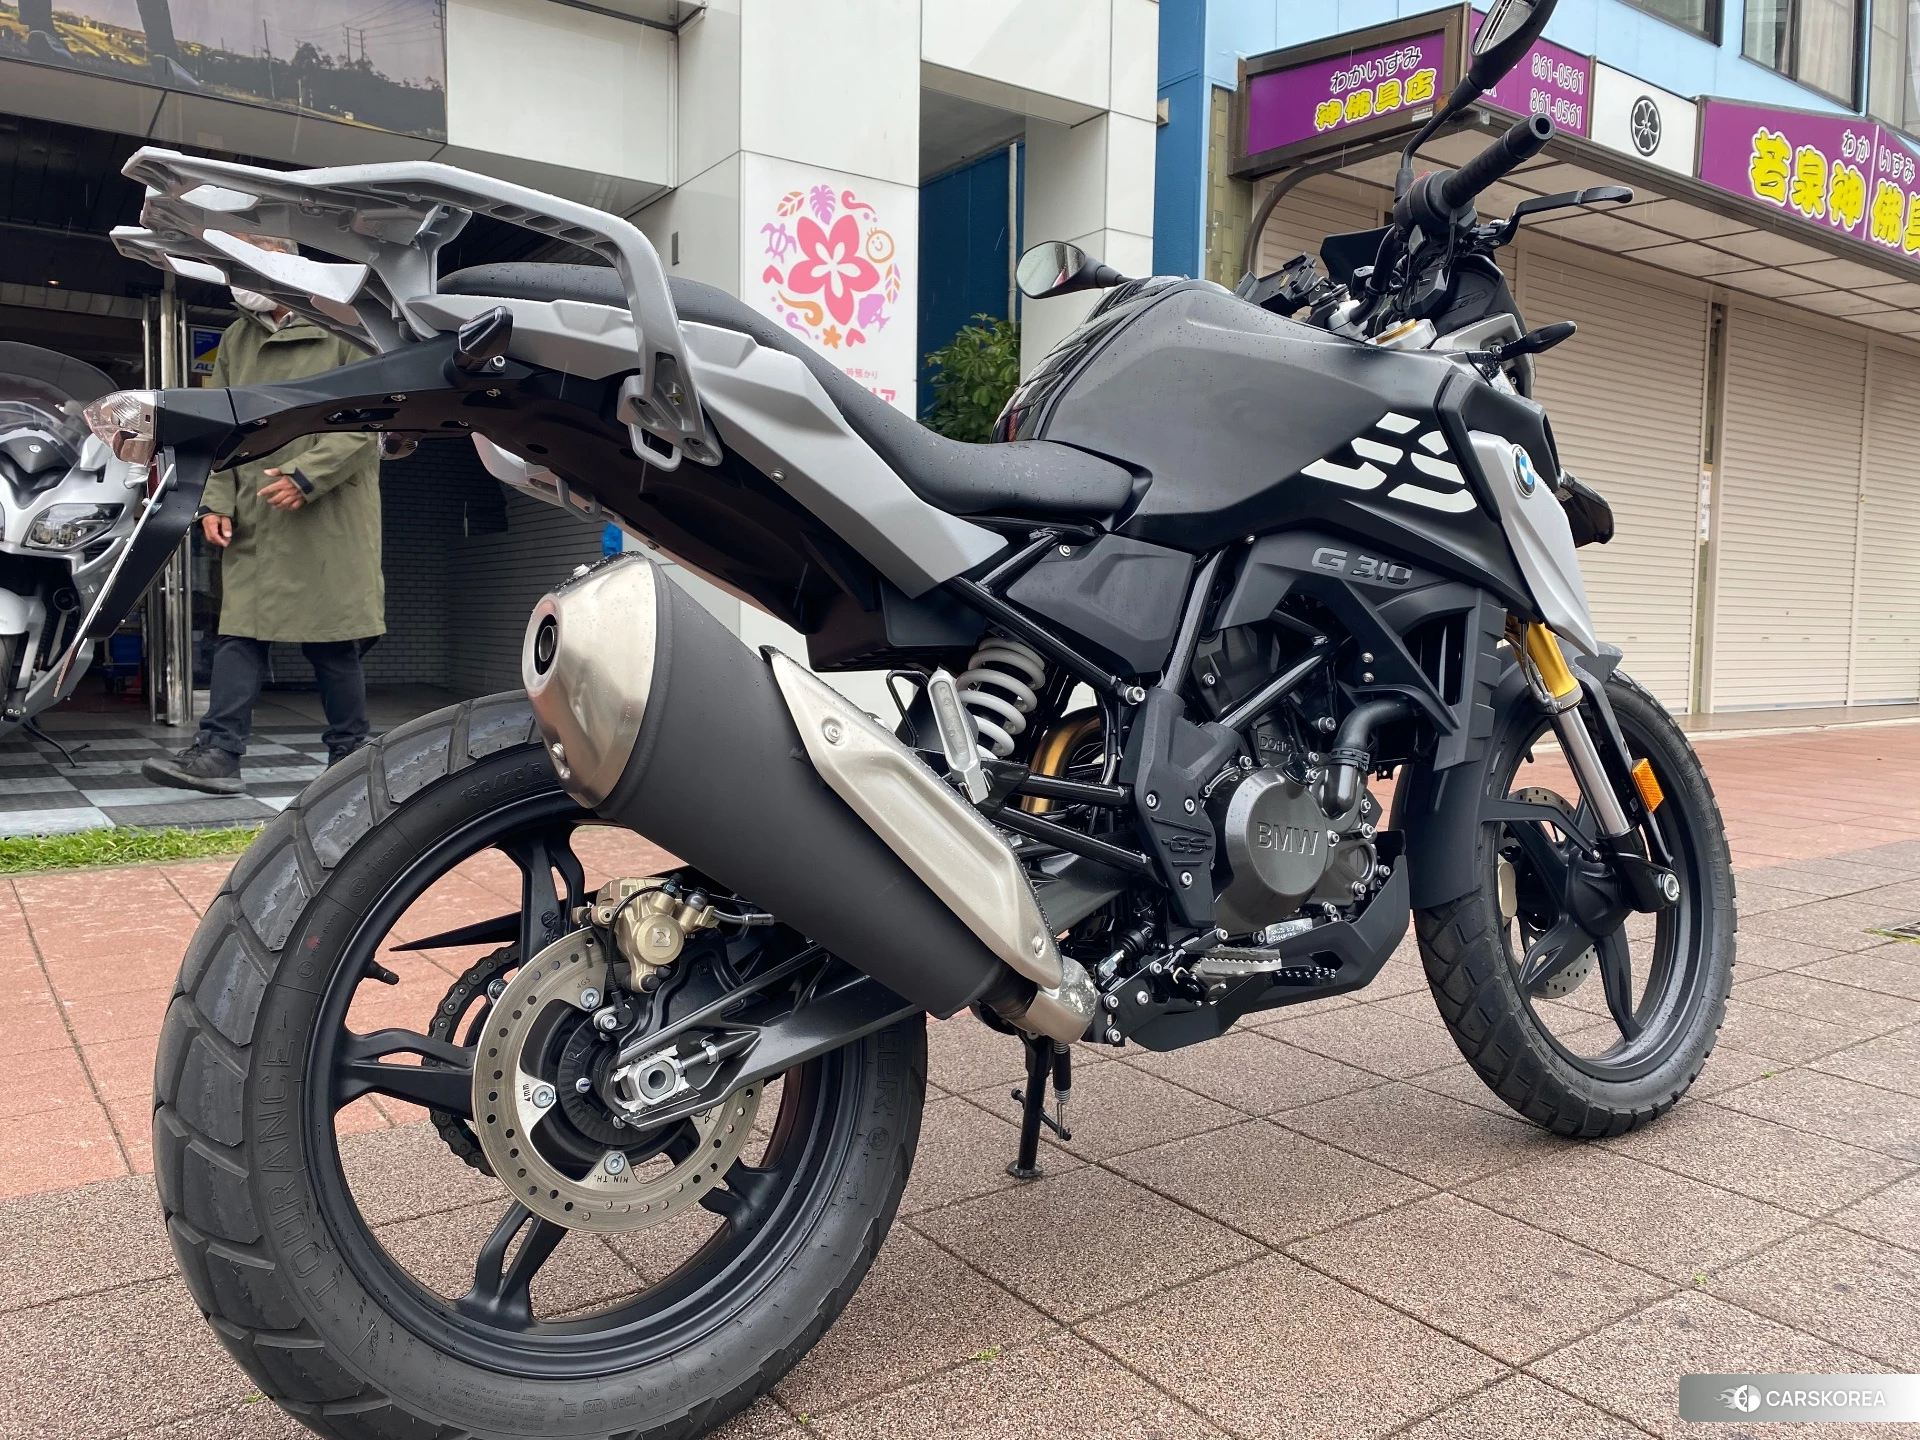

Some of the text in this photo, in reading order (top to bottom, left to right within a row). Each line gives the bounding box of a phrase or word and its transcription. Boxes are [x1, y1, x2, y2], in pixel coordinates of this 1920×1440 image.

[1330, 46, 1422, 93] わかいずみ
[1531, 52, 1585, 95] 861-0561
[1529, 88, 1583, 129] 861-0561
[843, 367, 878, 379] 時預かり
[1311, 547, 1414, 586] G 310
[1257, 821, 1319, 856] BMW
[258, 1039, 338, 1311] TOURANCE
